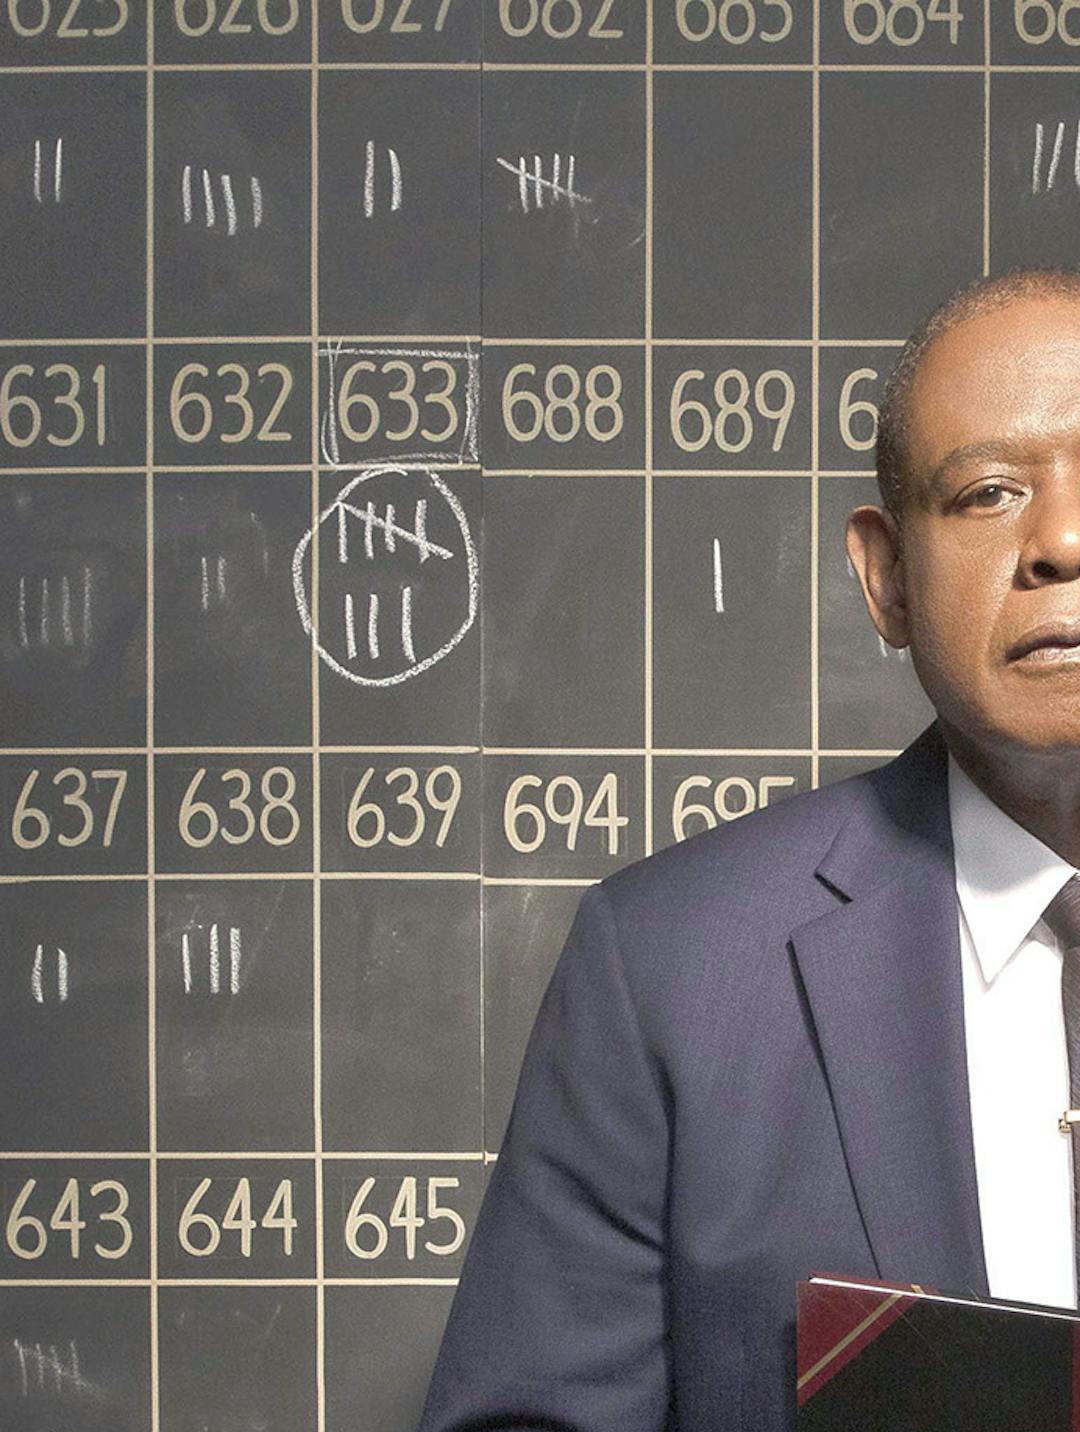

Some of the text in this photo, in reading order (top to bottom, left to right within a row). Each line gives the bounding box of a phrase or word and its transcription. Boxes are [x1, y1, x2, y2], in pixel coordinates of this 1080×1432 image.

[0, 363, 106, 448] 631
[170, 362, 293, 443] 632
[338, 360, 459, 443] 633
[502, 363, 624, 442] 688
[670, 368, 795, 453] 689
[12, 767, 128, 849] 637
[178, 766, 300, 848] 638
[347, 764, 462, 848] 639
[504, 772, 629, 855] 694
[6, 1177, 133, 1260] 643
[178, 1177, 298, 1258] 644
[345, 1176, 466, 1260] 645
